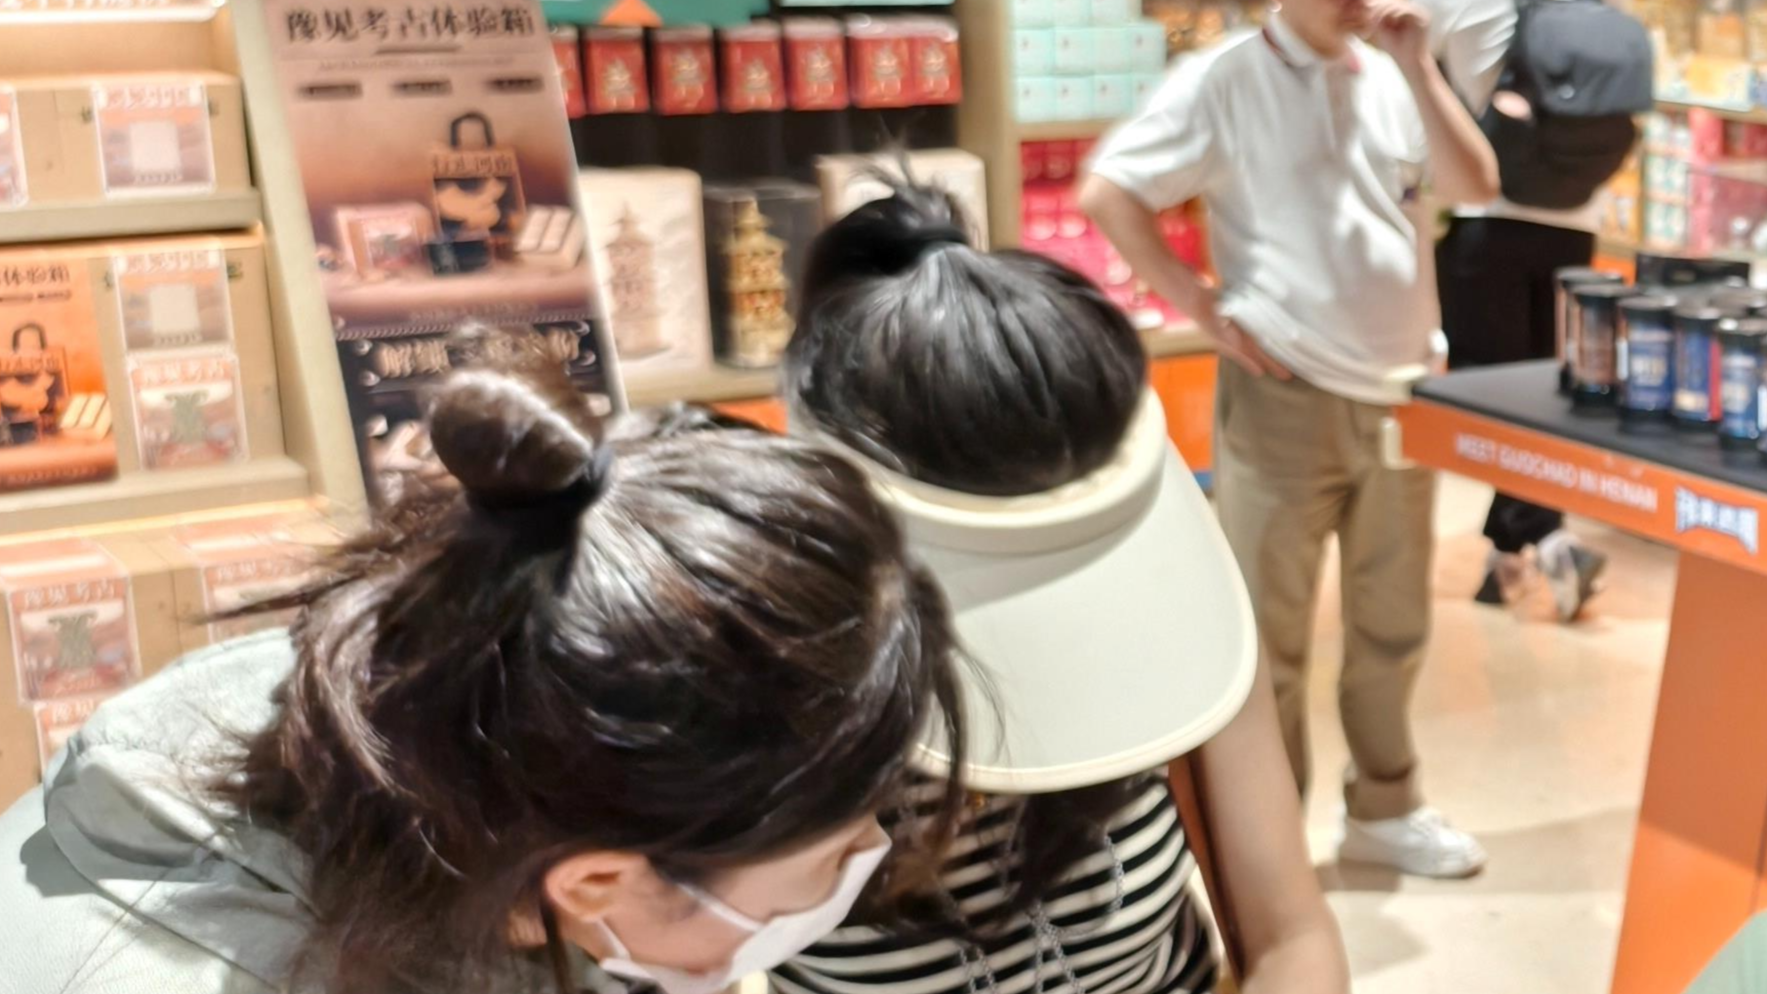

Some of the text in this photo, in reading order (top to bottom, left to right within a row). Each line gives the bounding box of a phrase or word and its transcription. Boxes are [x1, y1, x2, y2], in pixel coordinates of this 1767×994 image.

[0, 265, 70, 286] 体验箱
[1456, 432, 1496, 464] MEET
[1498, 445, 1578, 488] GUOCHAO
[1600, 473, 1658, 513] HENAN
